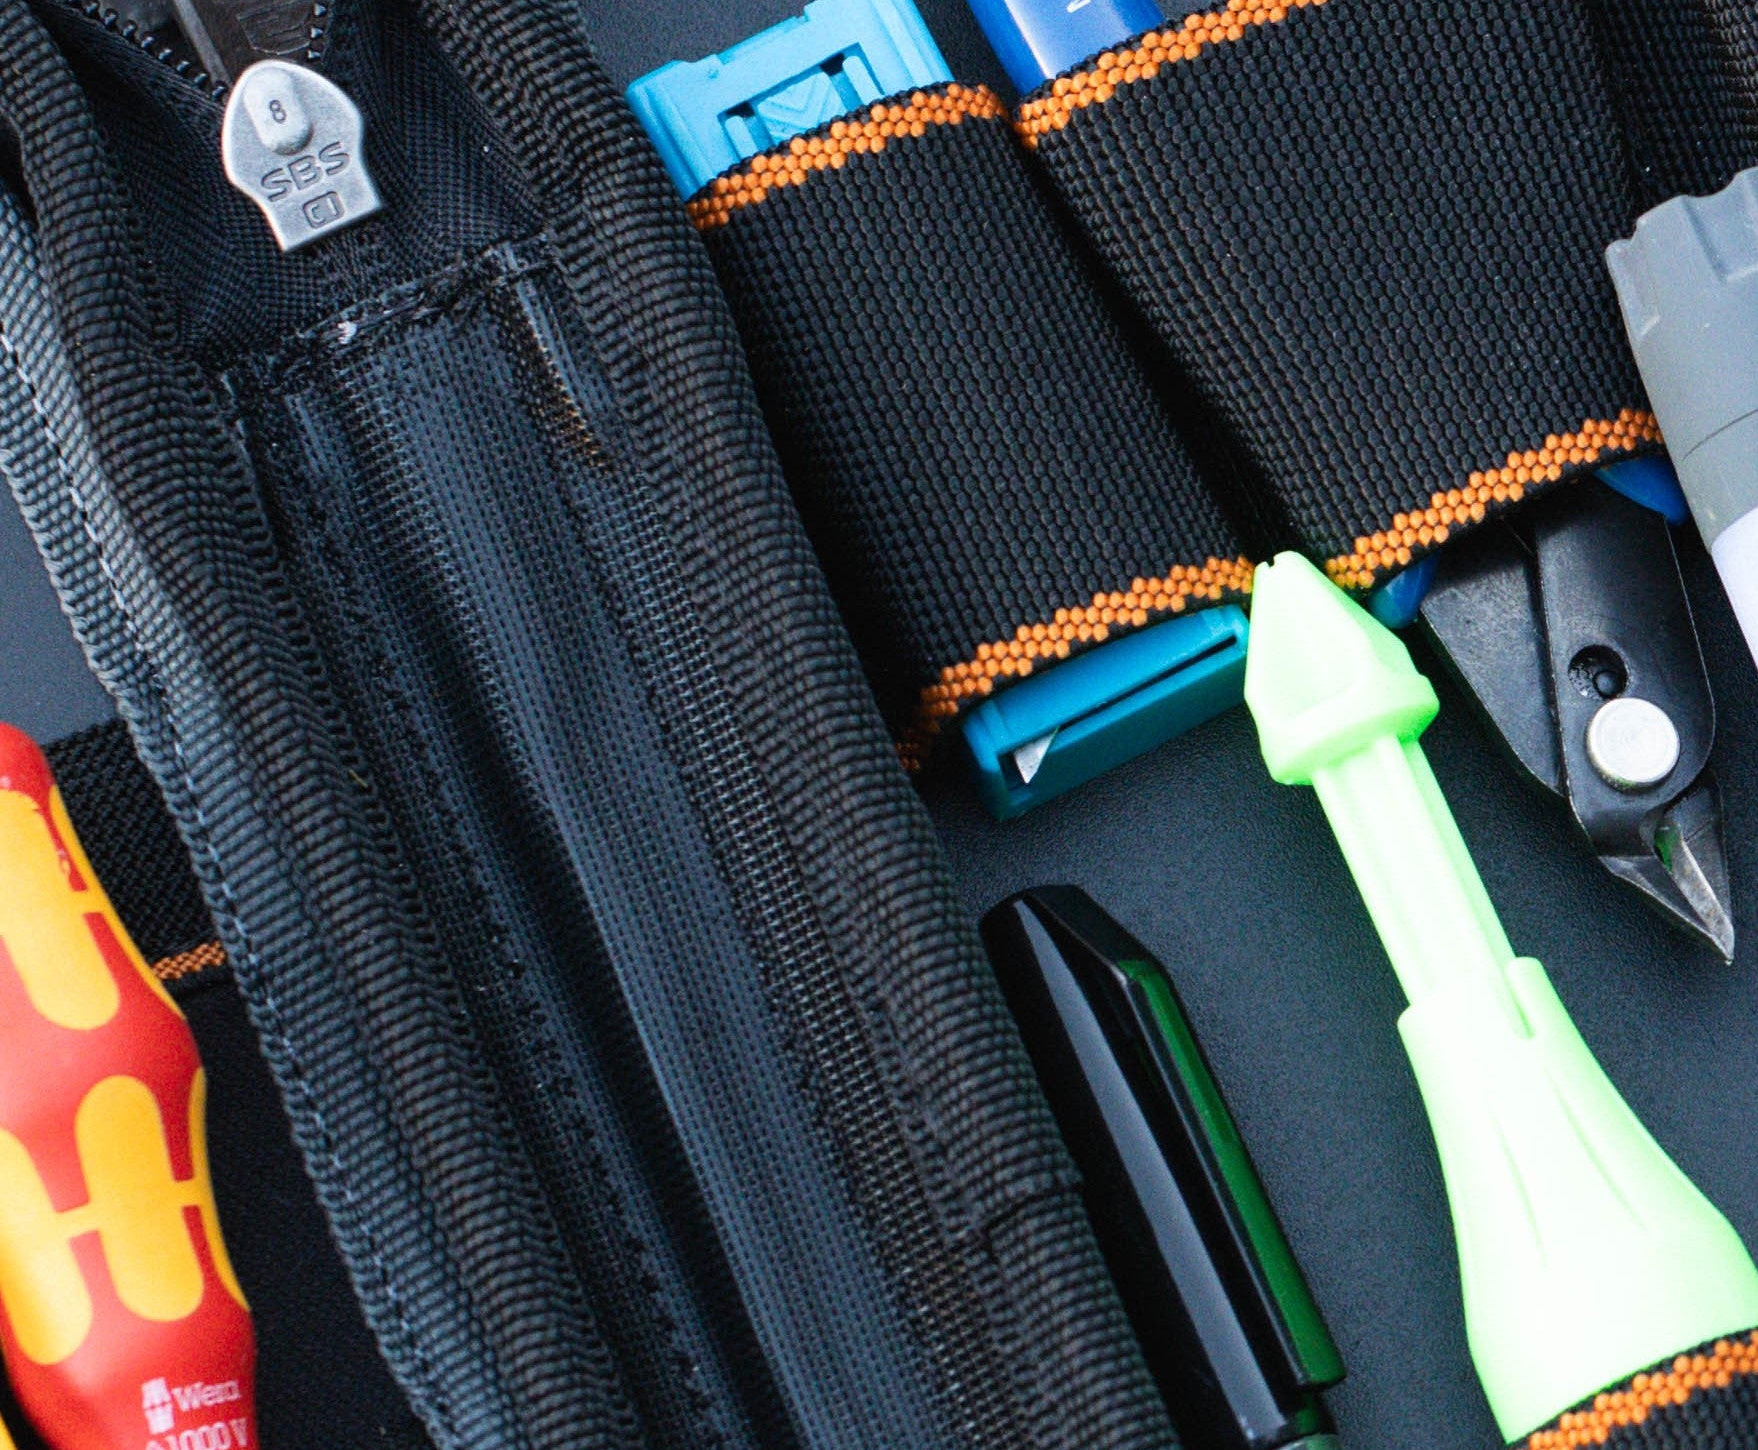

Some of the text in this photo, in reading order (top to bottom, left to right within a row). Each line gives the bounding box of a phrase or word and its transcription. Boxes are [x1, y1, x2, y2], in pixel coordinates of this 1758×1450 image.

[268, 99, 287, 124] 8
[260, 141, 350, 203] SBS
[172, 1379, 242, 1412] Wera
[229, 1417, 248, 1447] V
